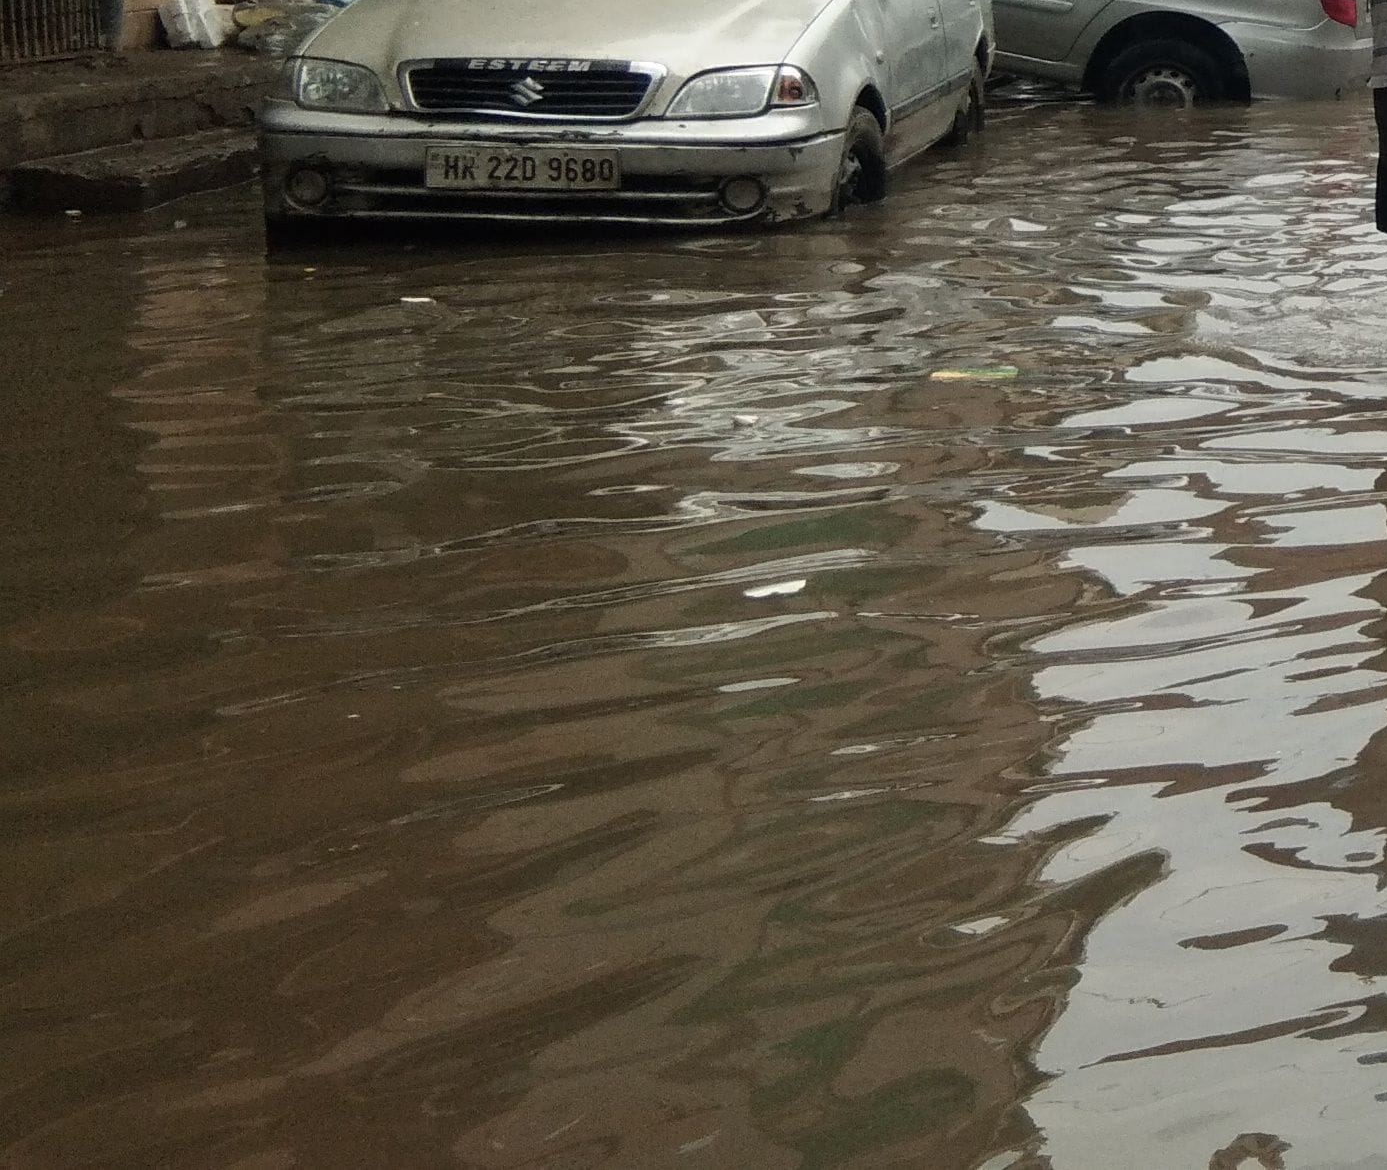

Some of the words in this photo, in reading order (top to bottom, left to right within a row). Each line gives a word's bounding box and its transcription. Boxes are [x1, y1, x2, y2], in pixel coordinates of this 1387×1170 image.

[468, 56, 592, 72] ESTEEM
[443, 154, 477, 180] HR
[487, 155, 537, 181] 22D
[547, 156, 614, 183] 9680
